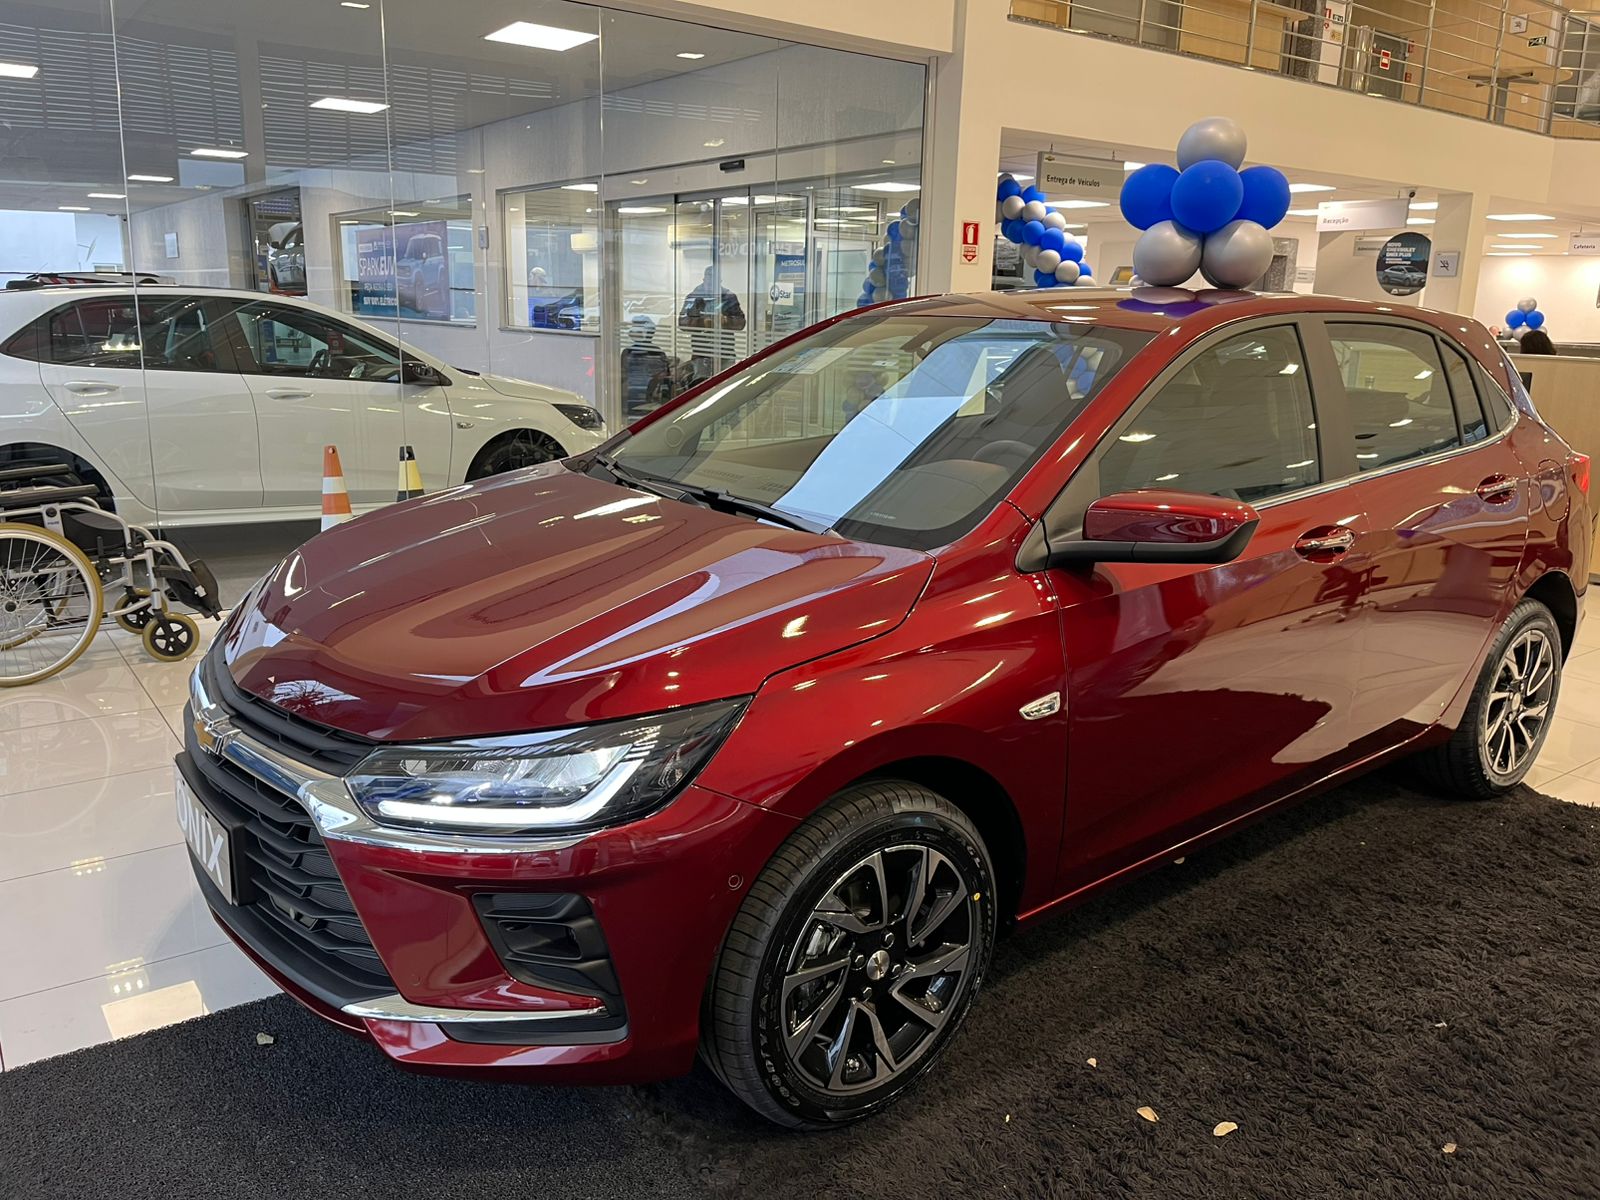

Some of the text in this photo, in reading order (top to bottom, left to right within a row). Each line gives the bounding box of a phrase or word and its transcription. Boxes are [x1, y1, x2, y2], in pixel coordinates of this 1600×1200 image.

[1046, 174, 1068, 185] Entrega
[1069, 176, 1076, 184] de
[1323, 217, 1349, 225] Recepção
[176, 779, 224, 888] ONIX
